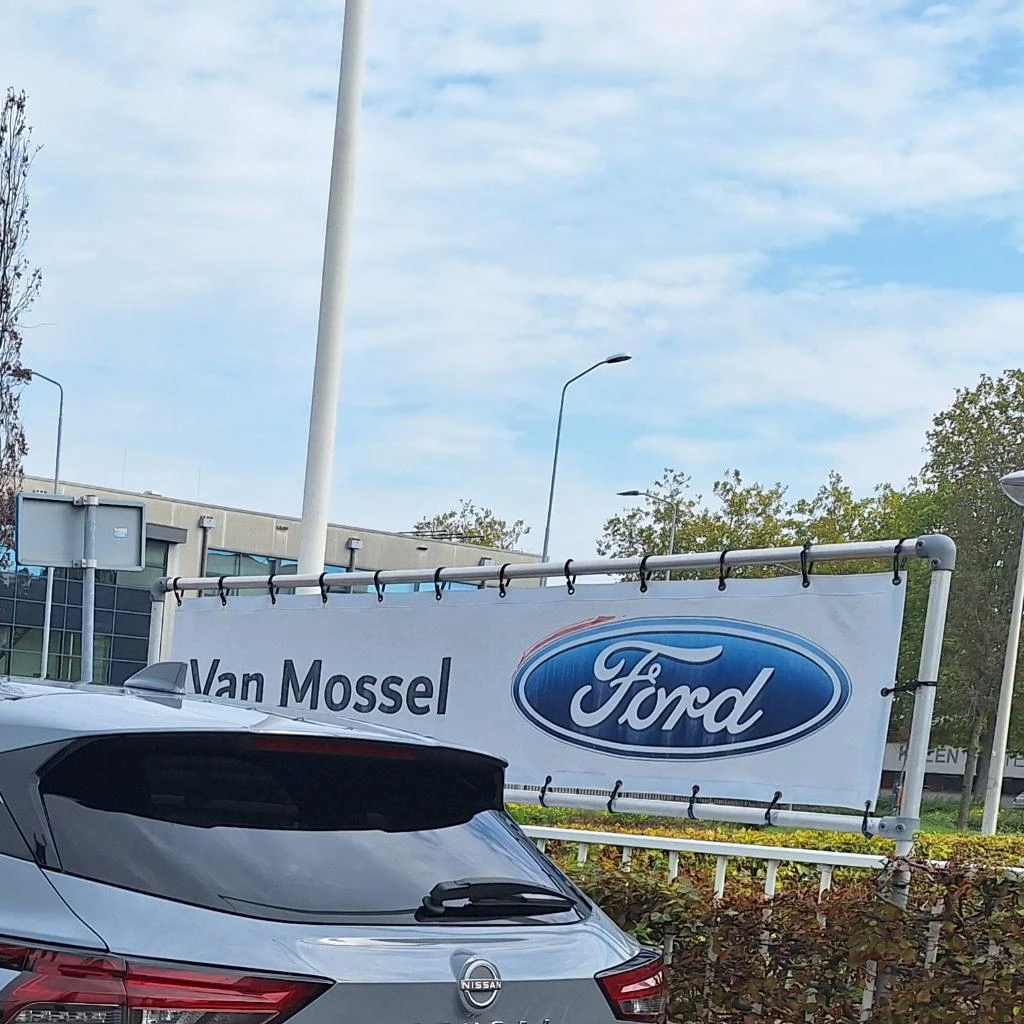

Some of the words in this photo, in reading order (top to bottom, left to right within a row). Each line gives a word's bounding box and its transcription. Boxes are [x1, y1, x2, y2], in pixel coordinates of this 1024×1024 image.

[189, 658, 265, 703] Van
[279, 656, 452, 716] Mossel
[570, 640, 776, 735] Ford
[460, 979, 502, 992] NISSAN
